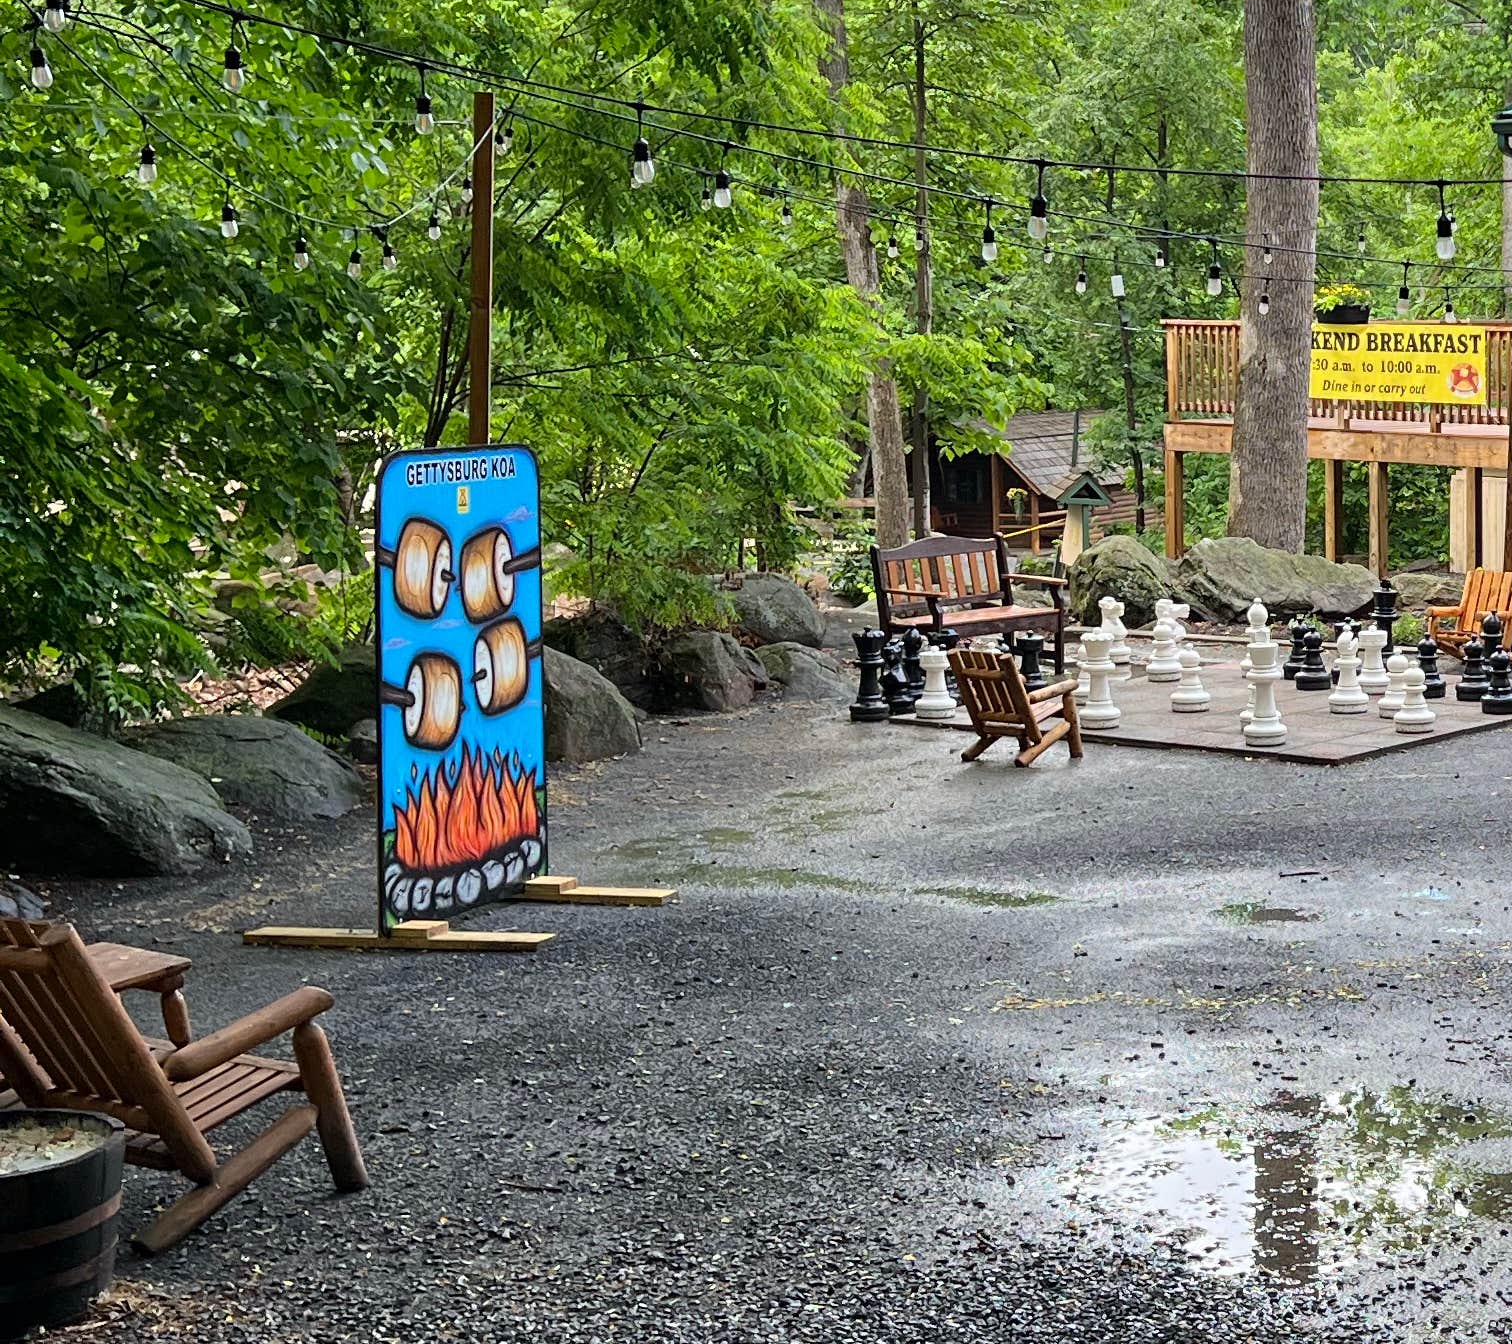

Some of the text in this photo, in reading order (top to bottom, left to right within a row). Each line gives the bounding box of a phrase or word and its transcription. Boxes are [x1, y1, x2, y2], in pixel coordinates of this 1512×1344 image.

[1311, 331, 1482, 354] KEND BREAKFAST
[1312, 358, 1441, 375] :30 a.m. to 10:00 a.m.
[1322, 379, 1426, 397] Dine in or carry out
[406, 456, 516, 485] GETTYSBURG KOA
